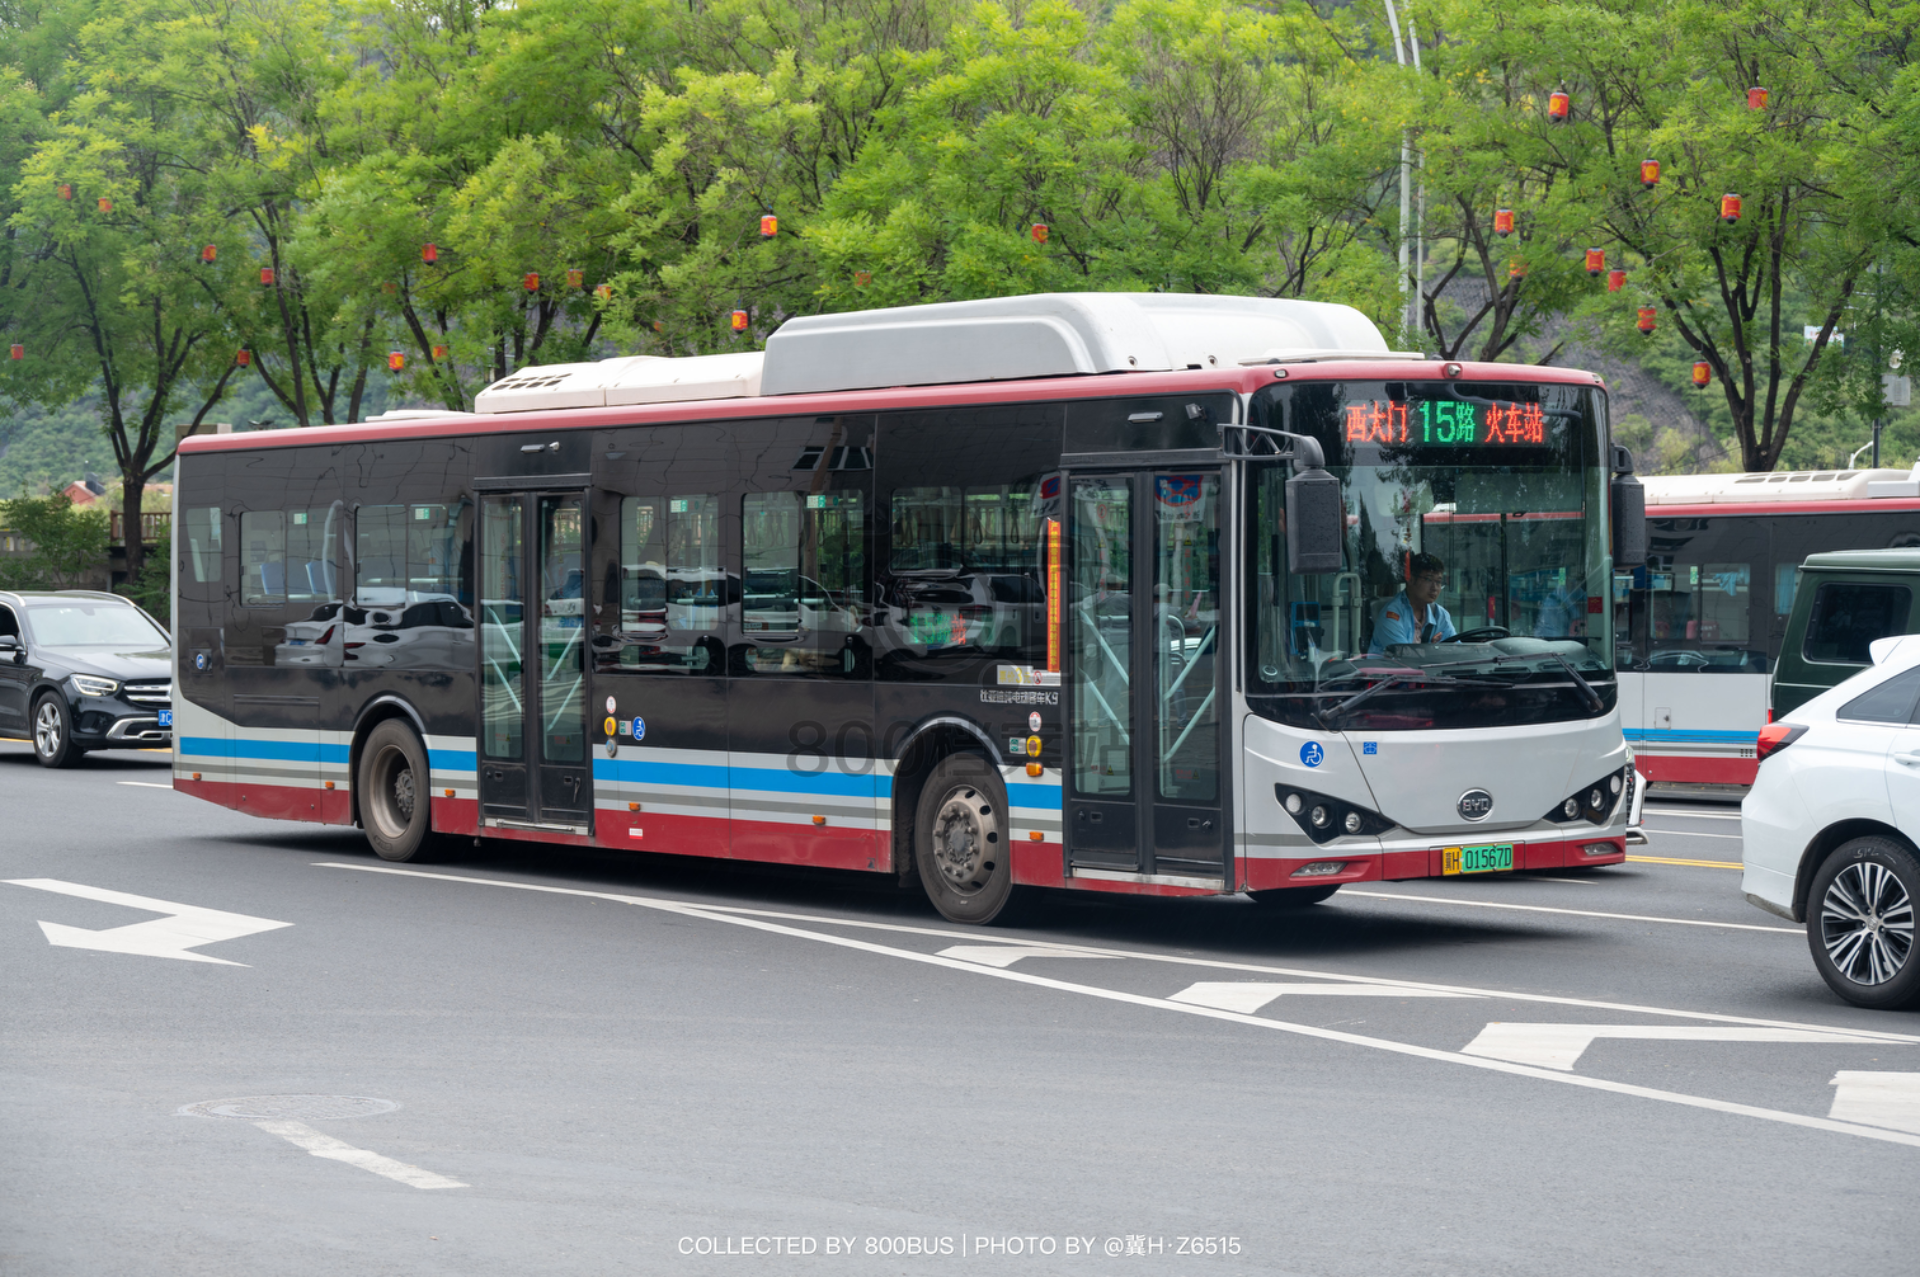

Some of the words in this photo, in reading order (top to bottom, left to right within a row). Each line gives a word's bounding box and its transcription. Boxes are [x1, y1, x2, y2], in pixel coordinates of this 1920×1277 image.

[1346, 400, 1407, 443] 西大门
[1419, 401, 1475, 443] 15路
[1485, 402, 1544, 443] 火车站
[1462, 797, 1489, 812] BYD
